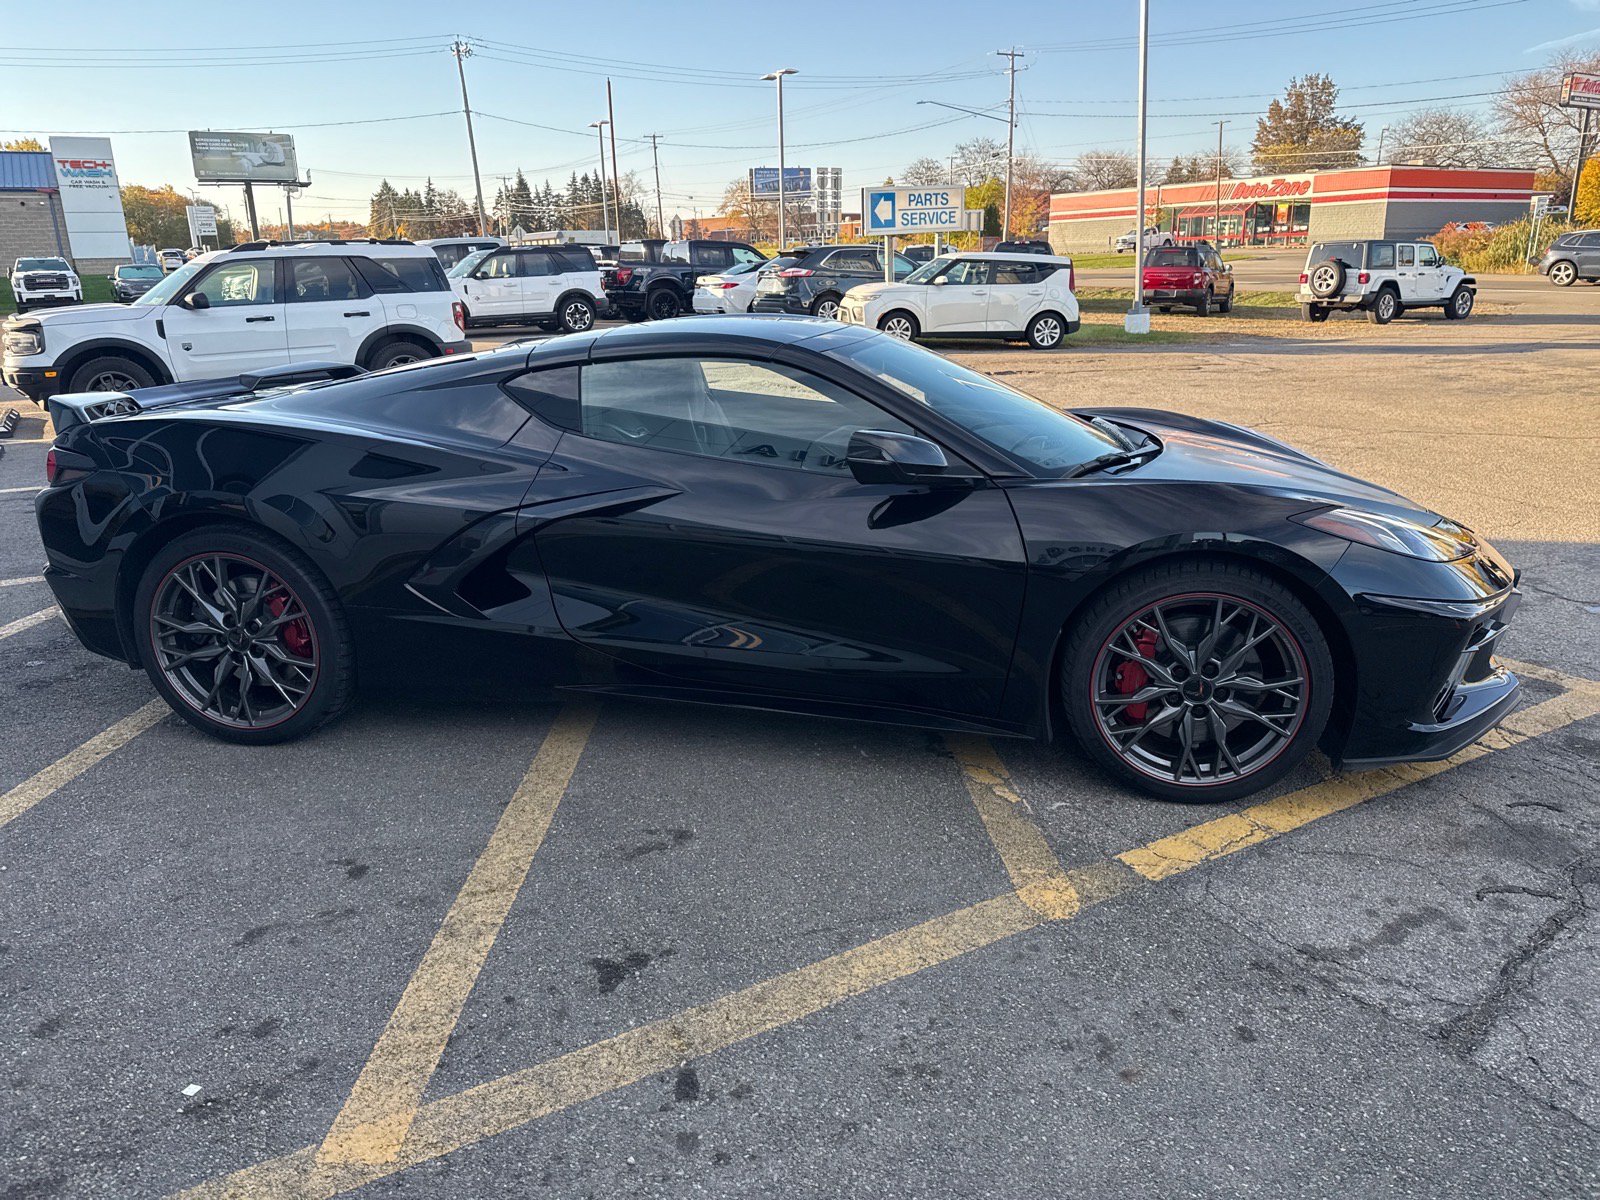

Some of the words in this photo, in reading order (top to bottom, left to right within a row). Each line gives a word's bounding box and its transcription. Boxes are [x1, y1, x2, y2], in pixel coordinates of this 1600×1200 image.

[60, 168, 112, 178] WASH
[1230, 179, 1311, 199] AutoZone
[908, 192, 949, 207] PARTS
[901, 211, 956, 226] SERVICE
